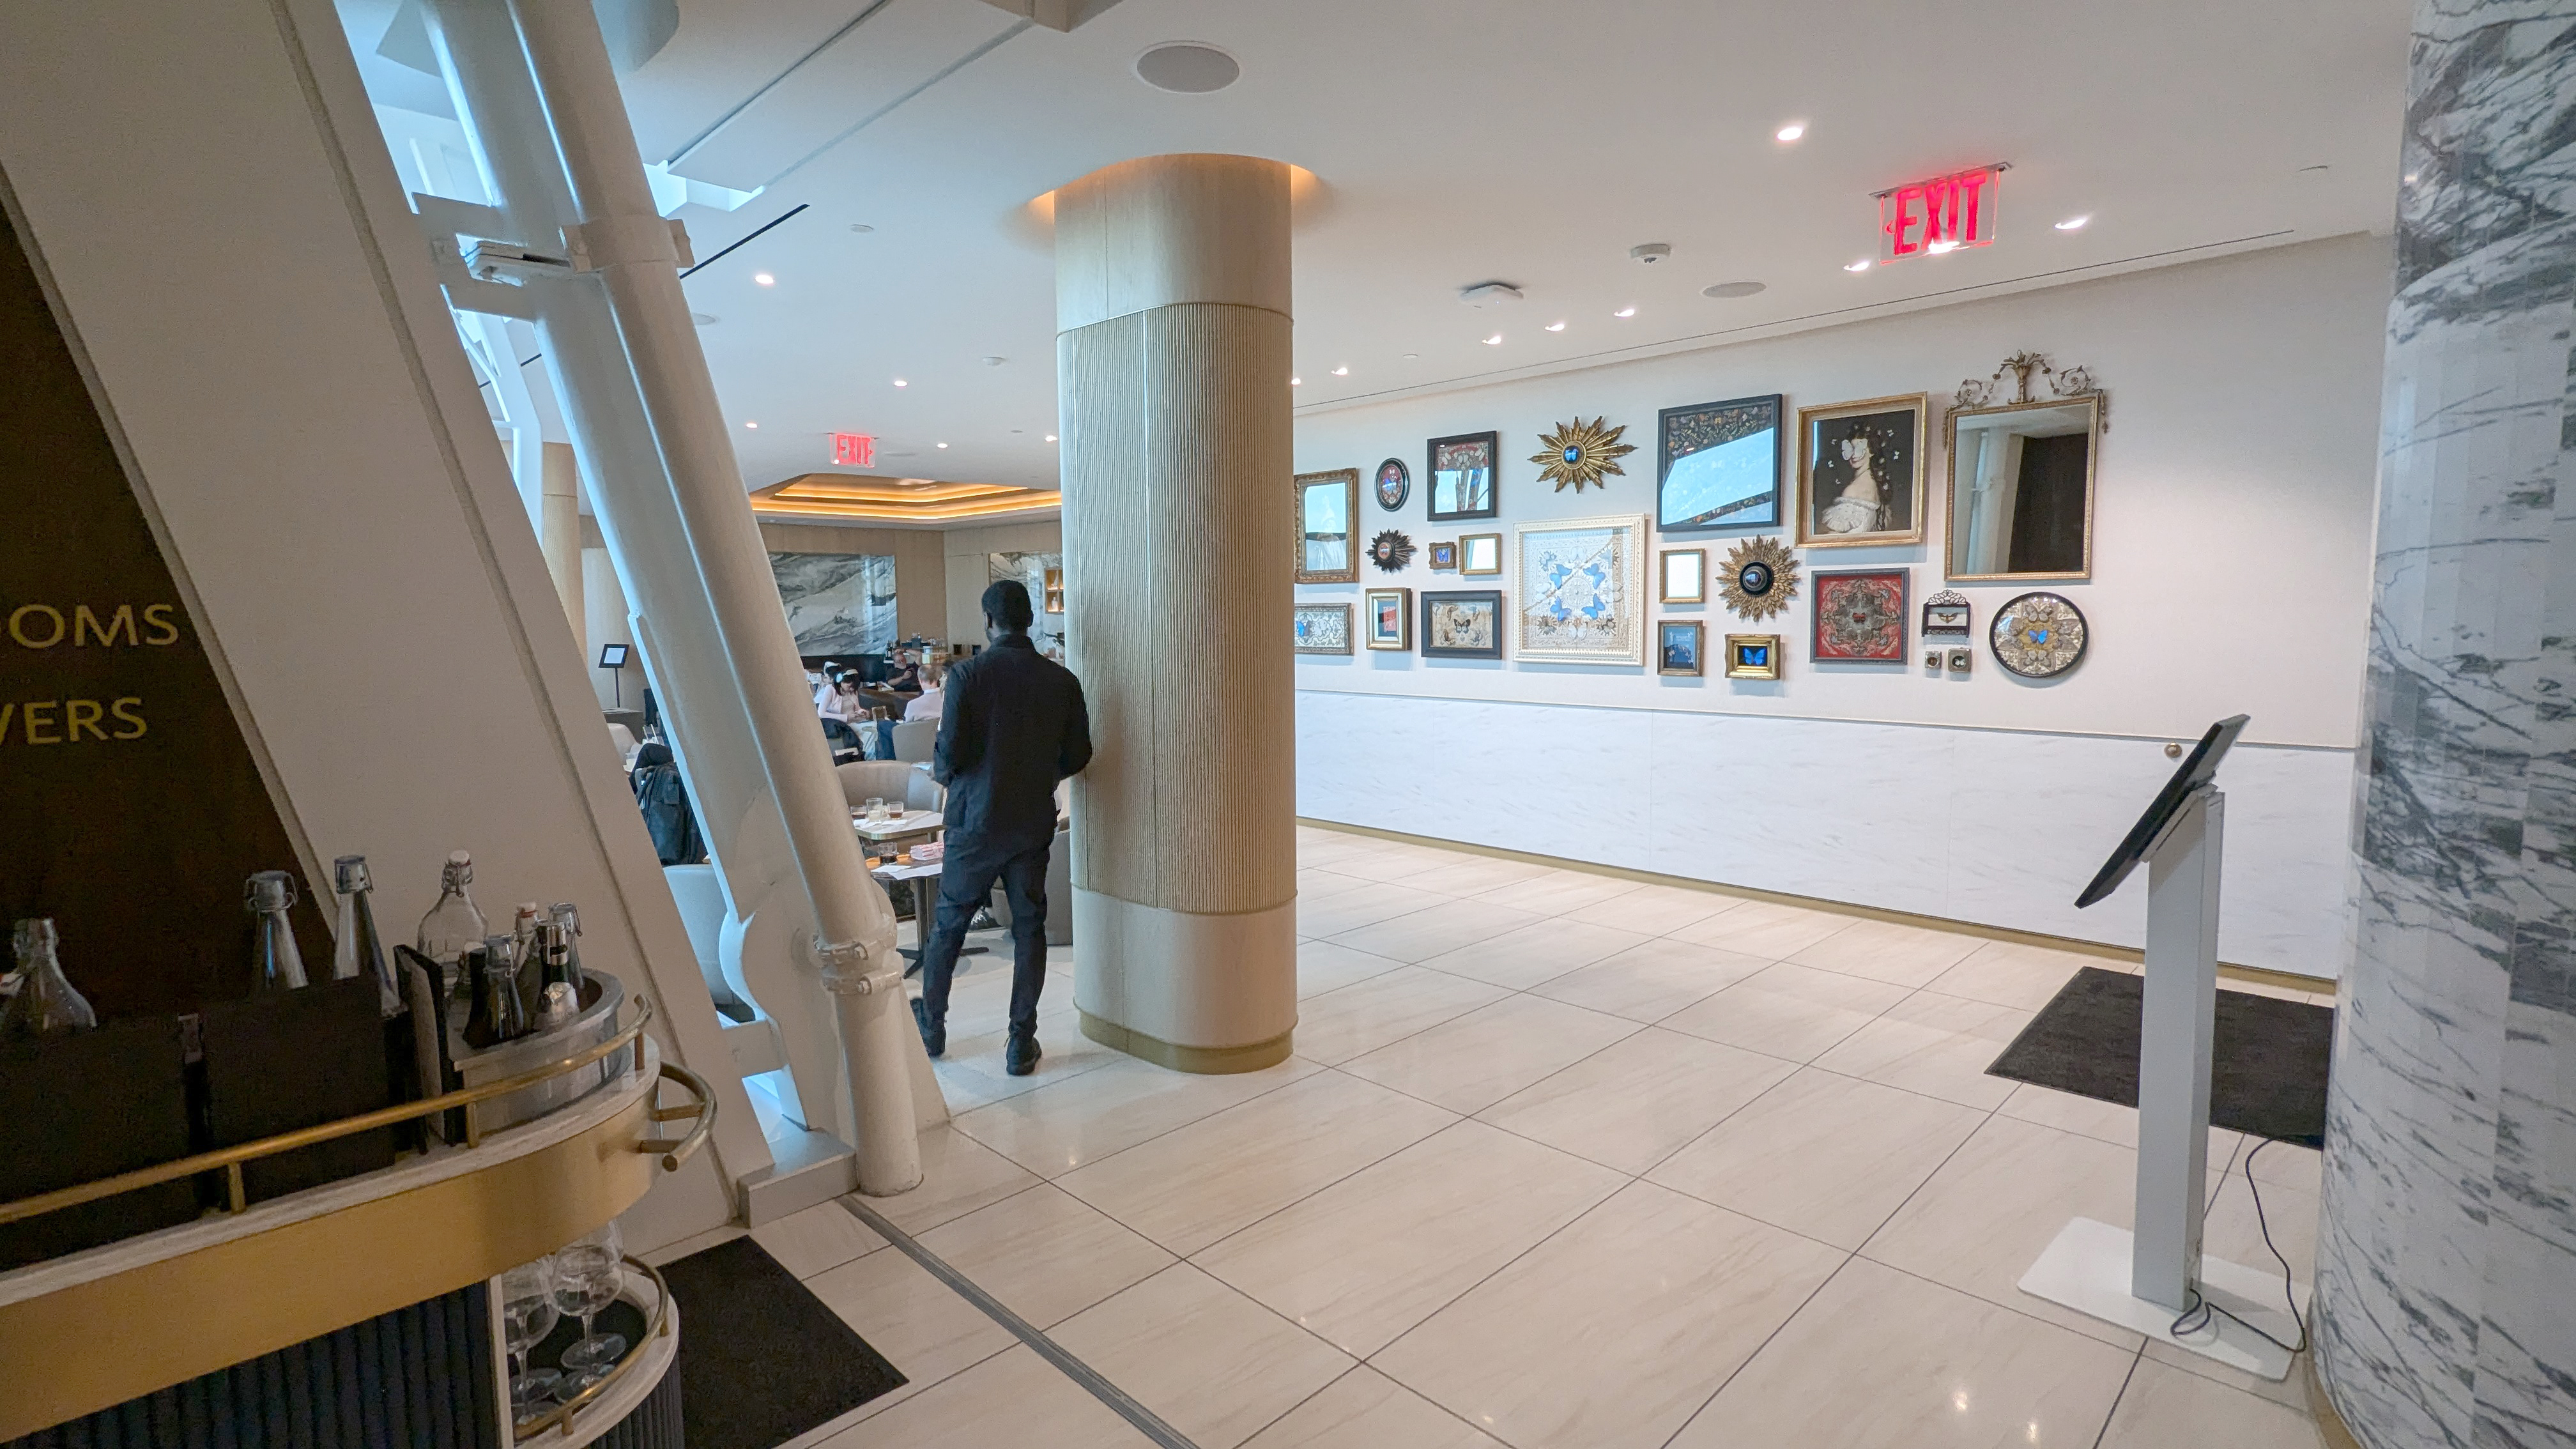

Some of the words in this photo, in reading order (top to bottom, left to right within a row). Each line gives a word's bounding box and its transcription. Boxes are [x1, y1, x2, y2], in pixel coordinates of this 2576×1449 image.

[1894, 173, 1987, 255] EXIT
[836, 434, 870, 464] EXIT
[0, 604, 180, 648] OMS
